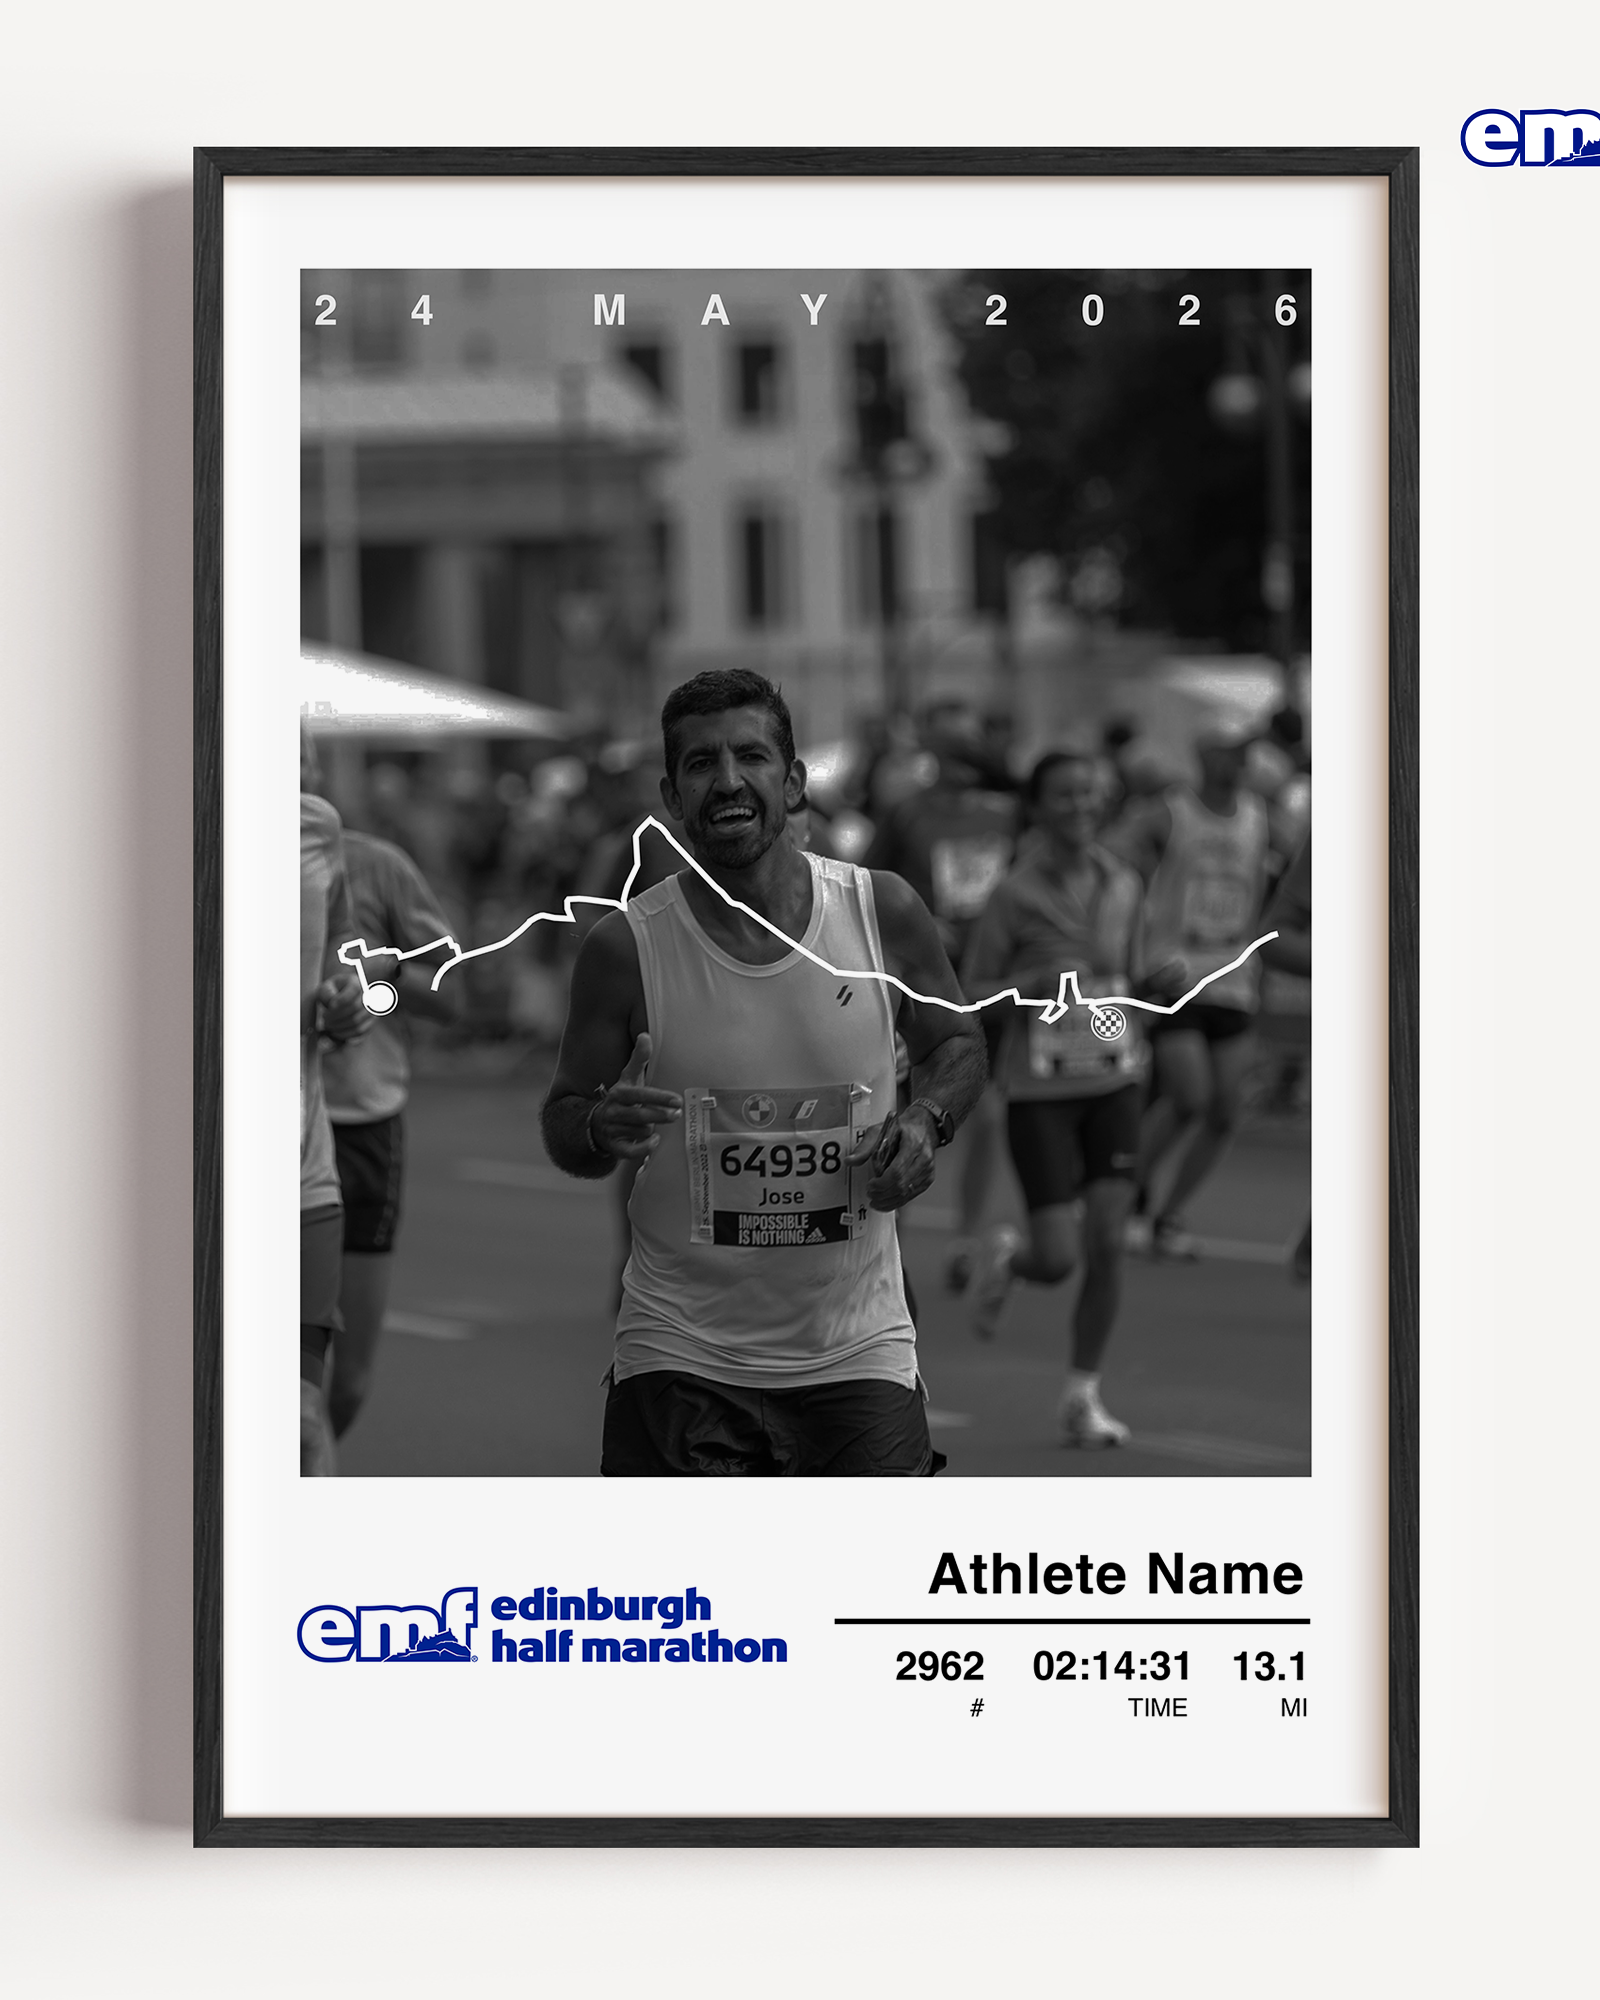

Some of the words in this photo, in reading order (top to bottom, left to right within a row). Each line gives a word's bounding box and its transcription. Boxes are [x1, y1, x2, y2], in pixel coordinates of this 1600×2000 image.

[720, 1141, 841, 1178] 64938
[759, 1187, 805, 1207] Jose
[738, 1213, 810, 1230] IMPOSSIBLE
[738, 1229, 750, 1245] IS
[752, 1229, 806, 1246] NOTHING
[927, 1552, 1127, 1596] Athlete
[1148, 1552, 1304, 1596] Name
[296, 1586, 478, 1663] emf
[490, 1586, 712, 1630] edinburgh
[491, 1628, 574, 1663] half
[581, 1628, 788, 1663] marathon
[895, 1650, 985, 1682] 2962
[1033, 1650, 1191, 1682] 02:14:31
[1232, 1650, 1306, 1682] 13.1
[969, 1697, 985, 1718] #
[1127, 1697, 1189, 1718] TIME
[1280, 1697, 1308, 1718] MI
